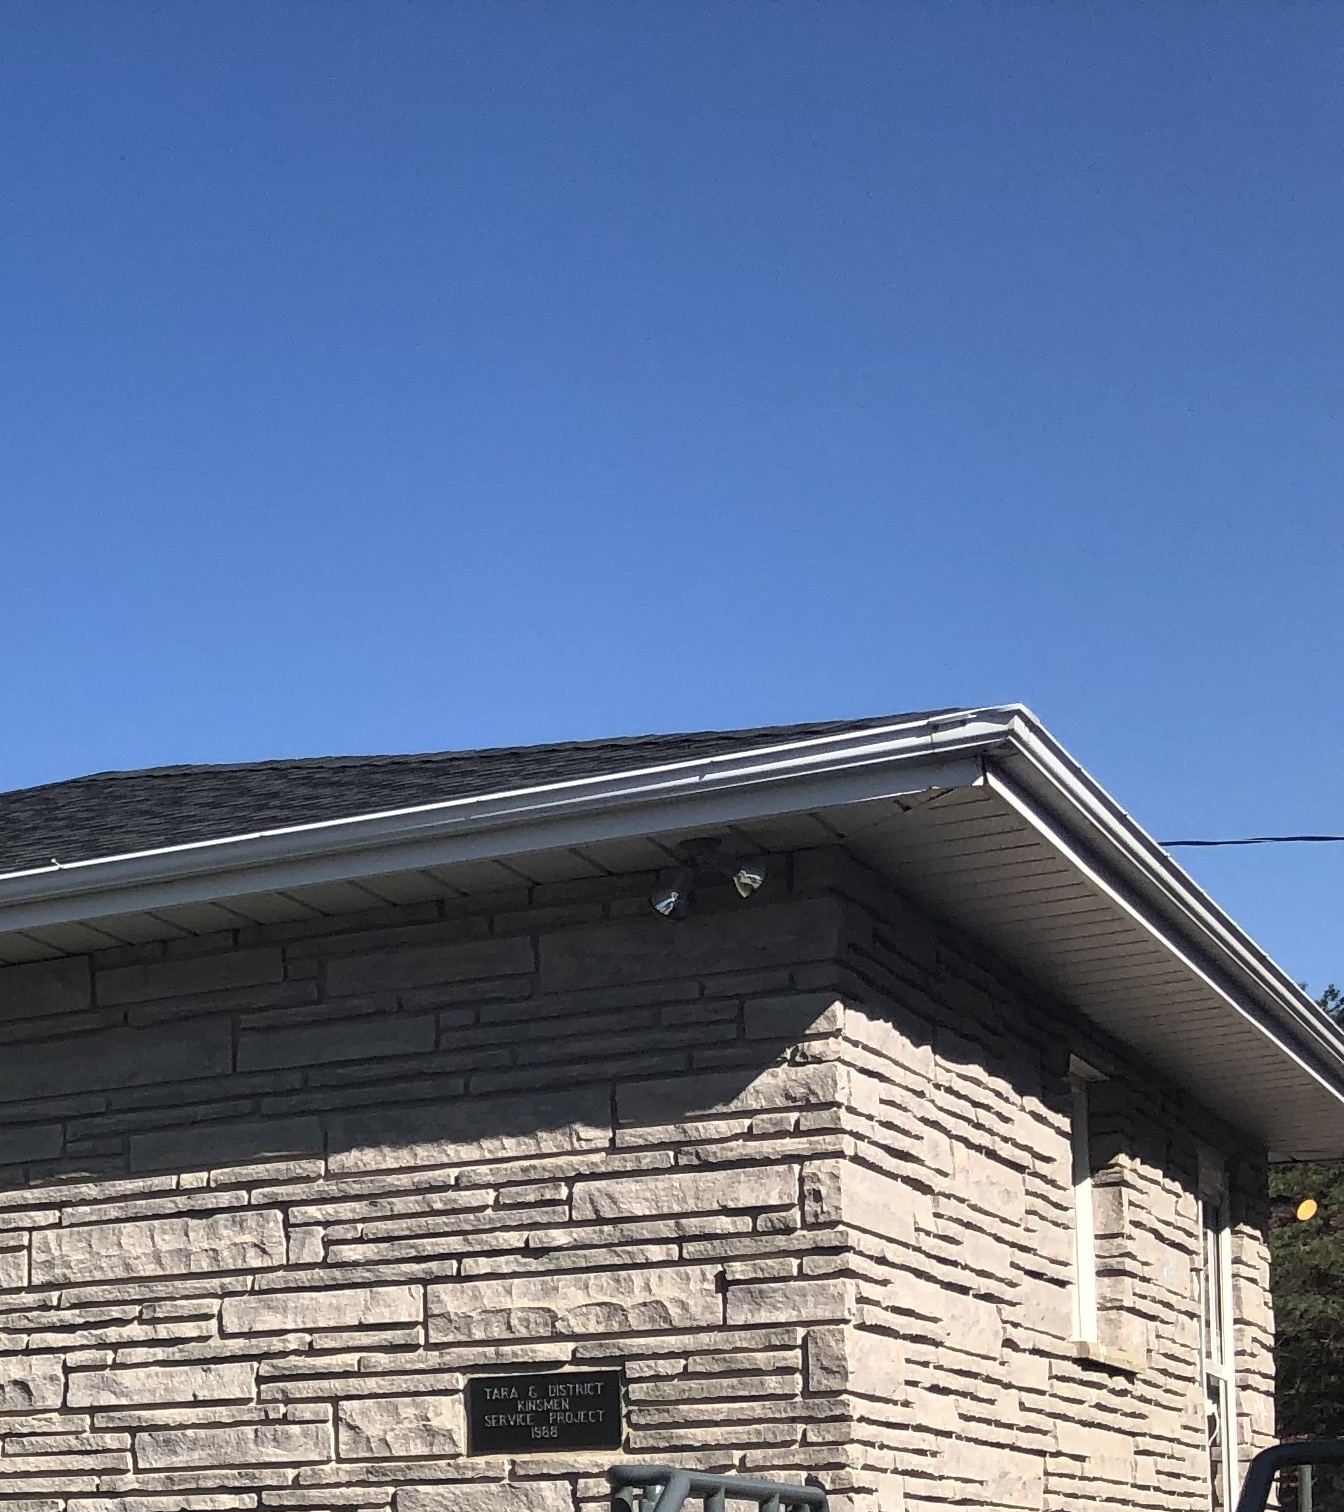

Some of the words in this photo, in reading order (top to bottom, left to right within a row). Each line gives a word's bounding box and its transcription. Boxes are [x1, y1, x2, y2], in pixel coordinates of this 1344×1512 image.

[484, 1386, 518, 1400] TARA
[528, 1385, 538, 1398] &
[548, 1382, 604, 1397] DISTRICT
[517, 1398, 570, 1412] KINSMEN
[484, 1413, 535, 1427] SERVICE
[549, 1410, 605, 1424] PROJECT
[531, 1426, 558, 1438] 1988
